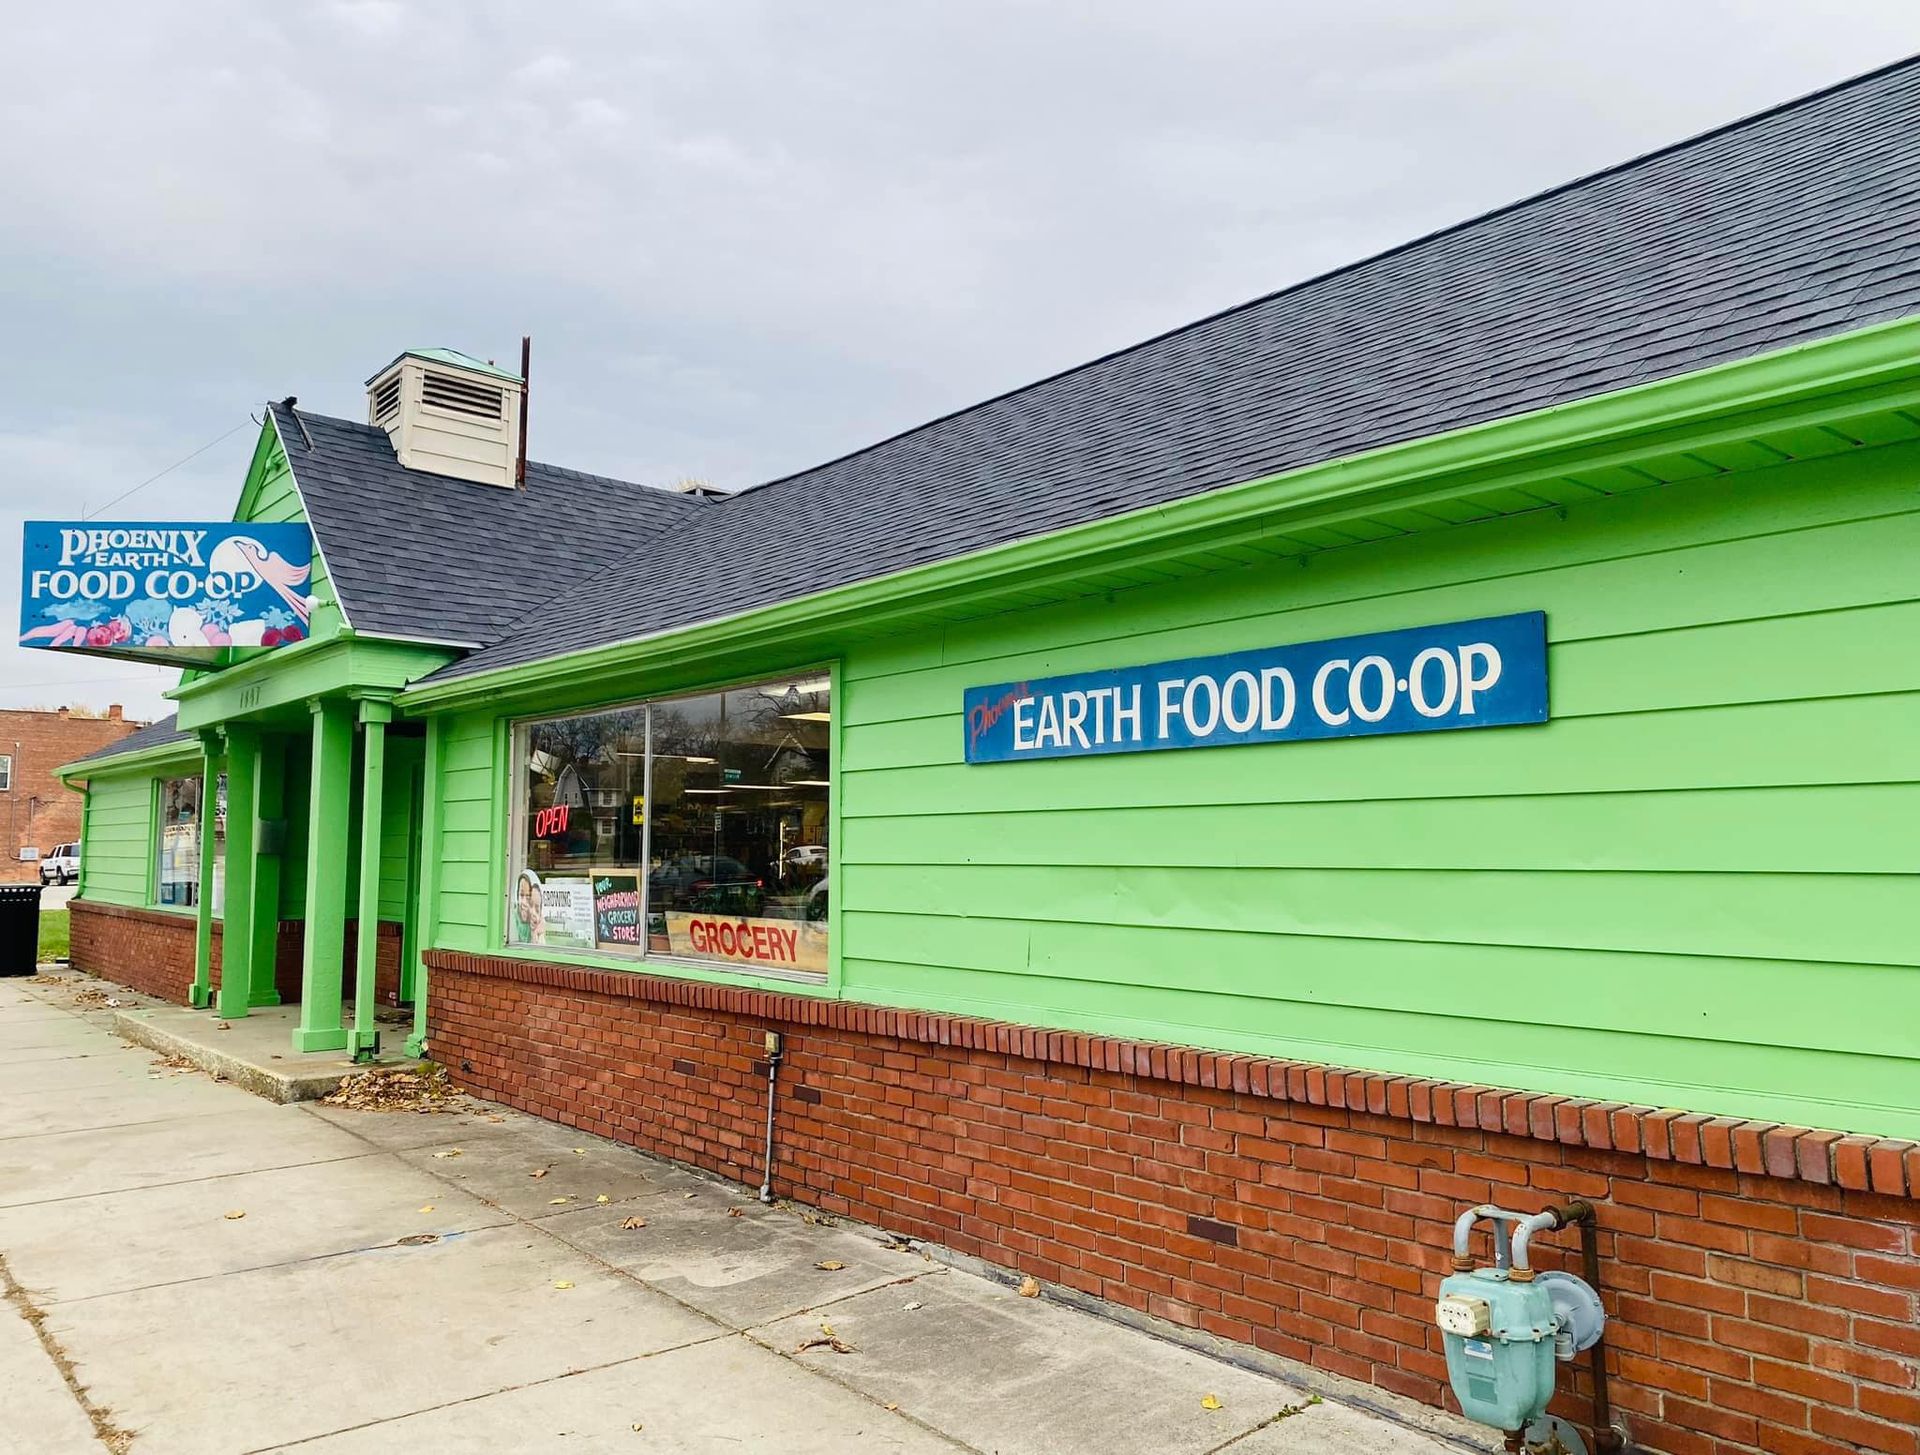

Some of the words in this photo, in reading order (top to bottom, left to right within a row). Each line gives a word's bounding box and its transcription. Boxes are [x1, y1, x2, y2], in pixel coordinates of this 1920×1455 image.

[58, 529, 207, 567] PHOENIX
[94, 552, 169, 570] EARTH
[31, 570, 136, 599] FOOD
[1013, 684, 1142, 751] EARTH
[1158, 667, 1296, 738] FOOD
[535, 804, 569, 838] OPEN
[607, 909, 637, 925] GROCERY
[612, 923, 640, 942] STORE!
[689, 919, 798, 962] GROCERY
